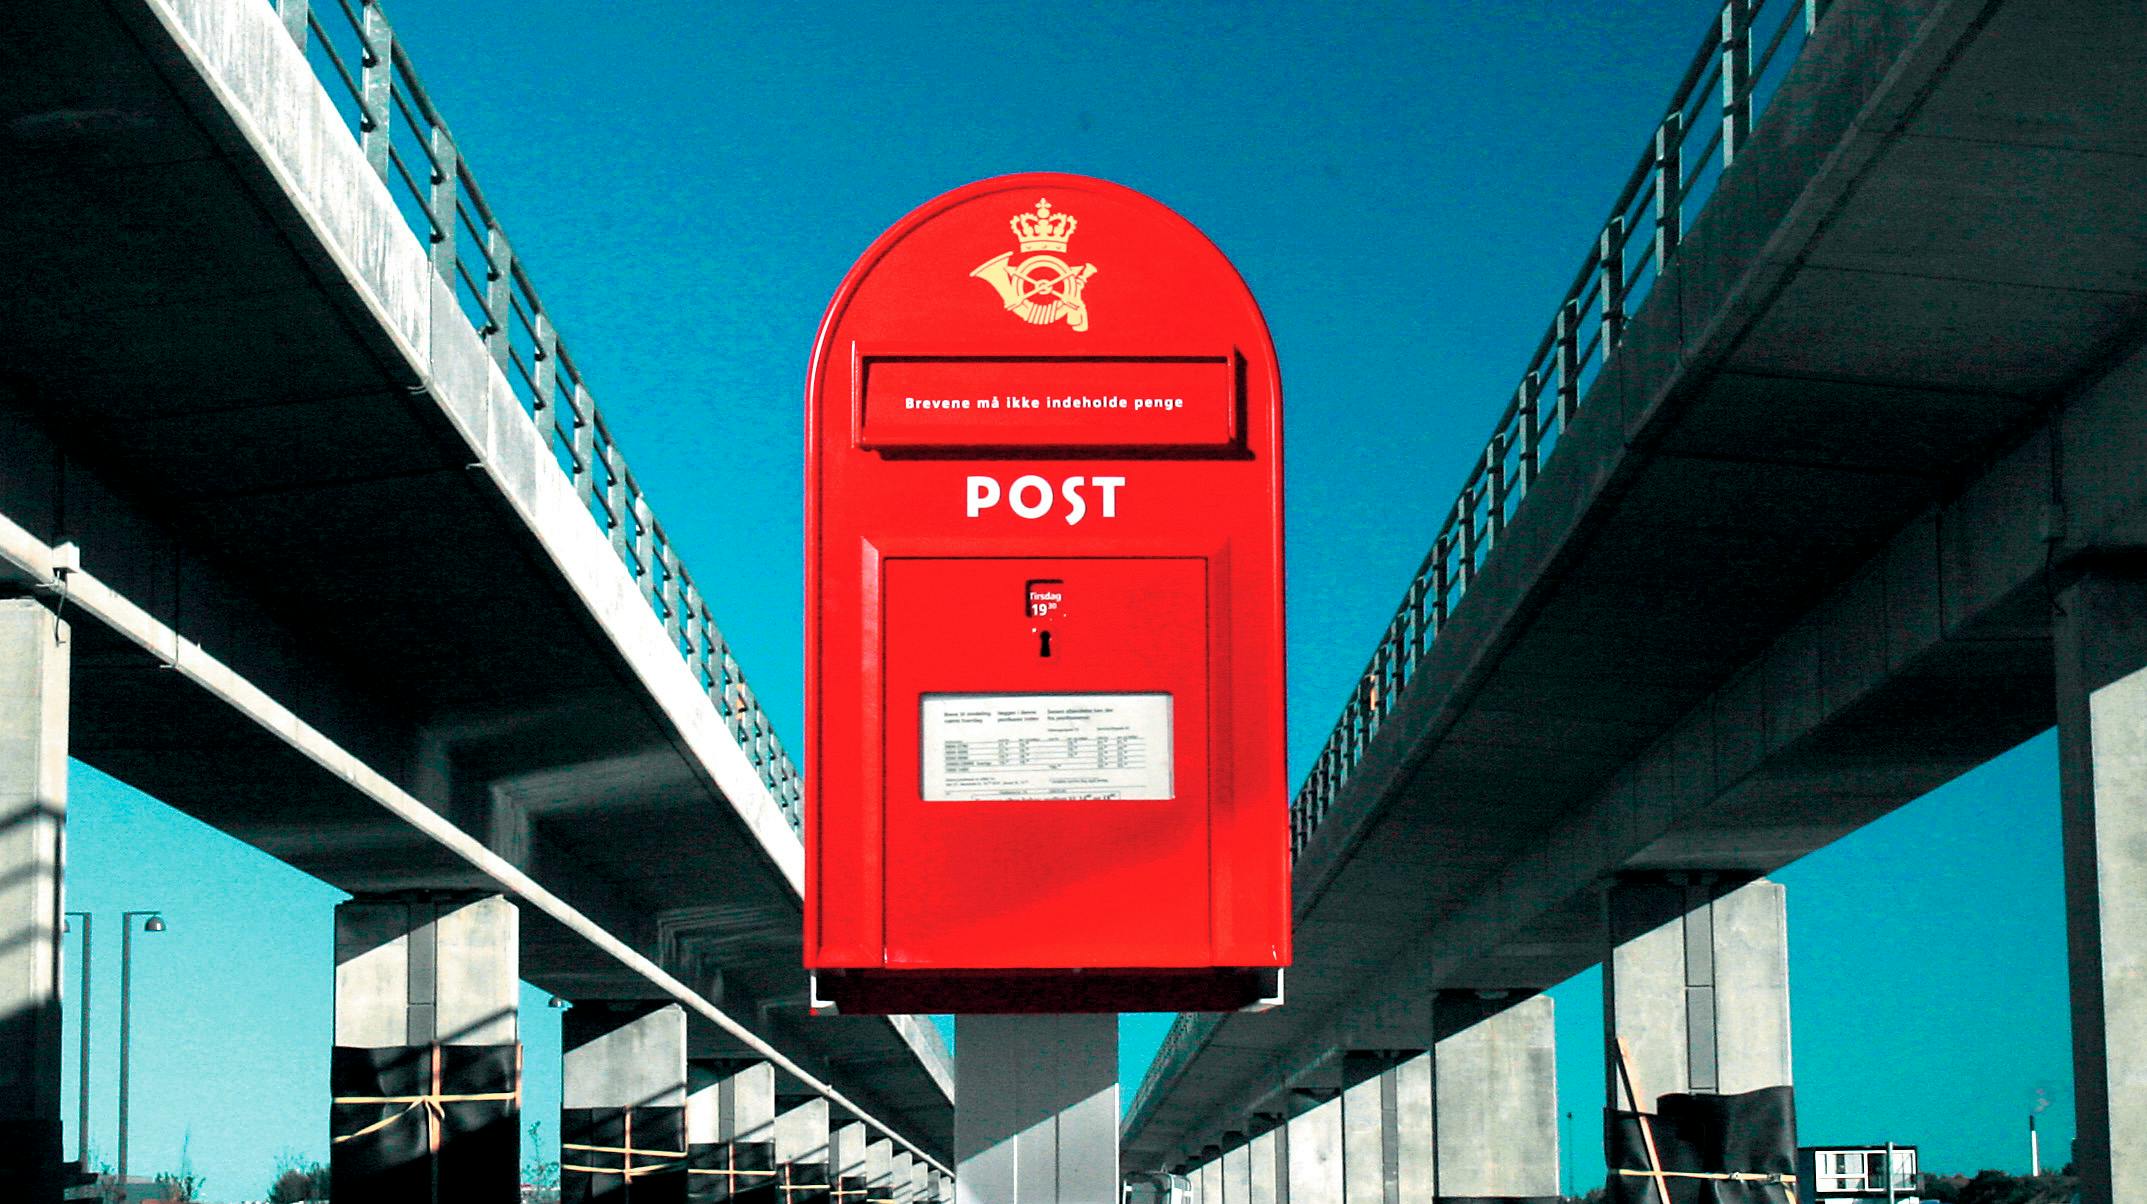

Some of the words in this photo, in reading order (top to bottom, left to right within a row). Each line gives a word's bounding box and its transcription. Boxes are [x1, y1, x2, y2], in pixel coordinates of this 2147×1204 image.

[905, 397, 970, 410] Brevene
[977, 395, 1000, 409] må
[1006, 396, 1040, 409] ikke
[1046, 396, 1128, 409] indeholde
[1134, 398, 1184, 411] penge
[966, 474, 1126, 526] POST
[1029, 592, 1062, 602] Tirsdag
